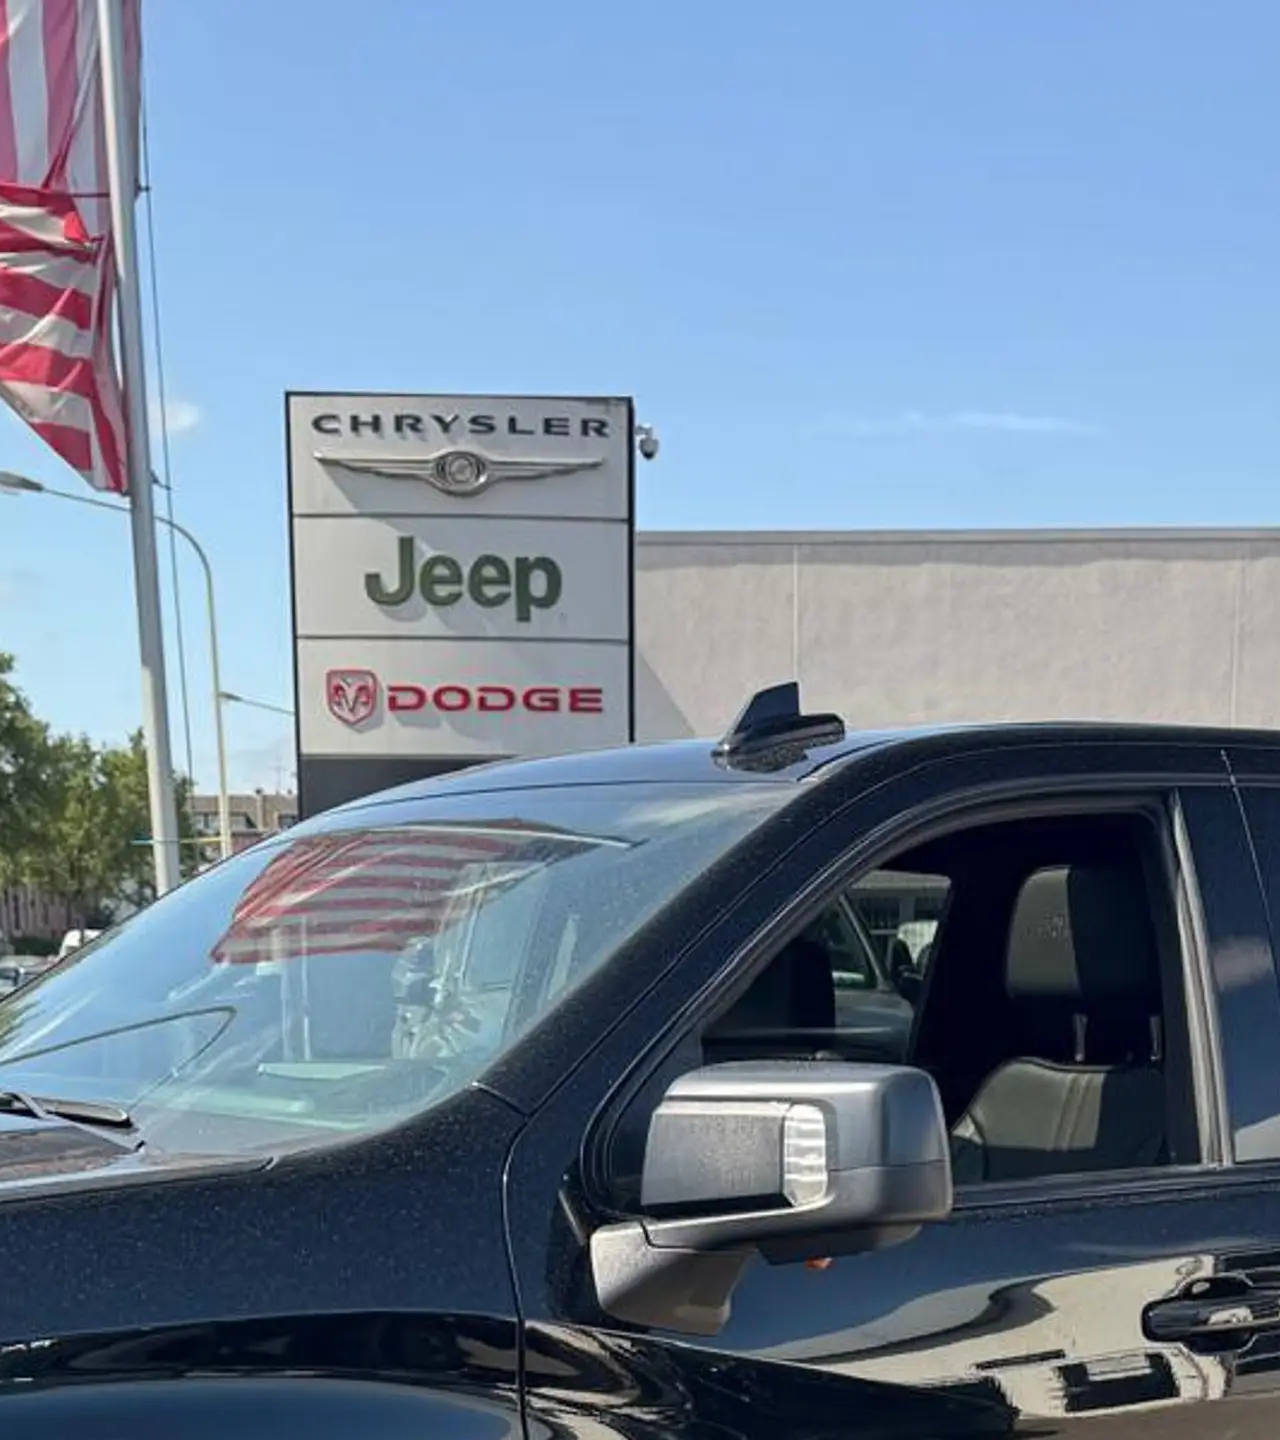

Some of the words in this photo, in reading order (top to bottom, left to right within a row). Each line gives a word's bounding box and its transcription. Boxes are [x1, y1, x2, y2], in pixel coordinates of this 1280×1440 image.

[312, 414, 610, 438] CHRYSLER
[365, 536, 562, 622] Jeep
[387, 685, 603, 714] DODGE
